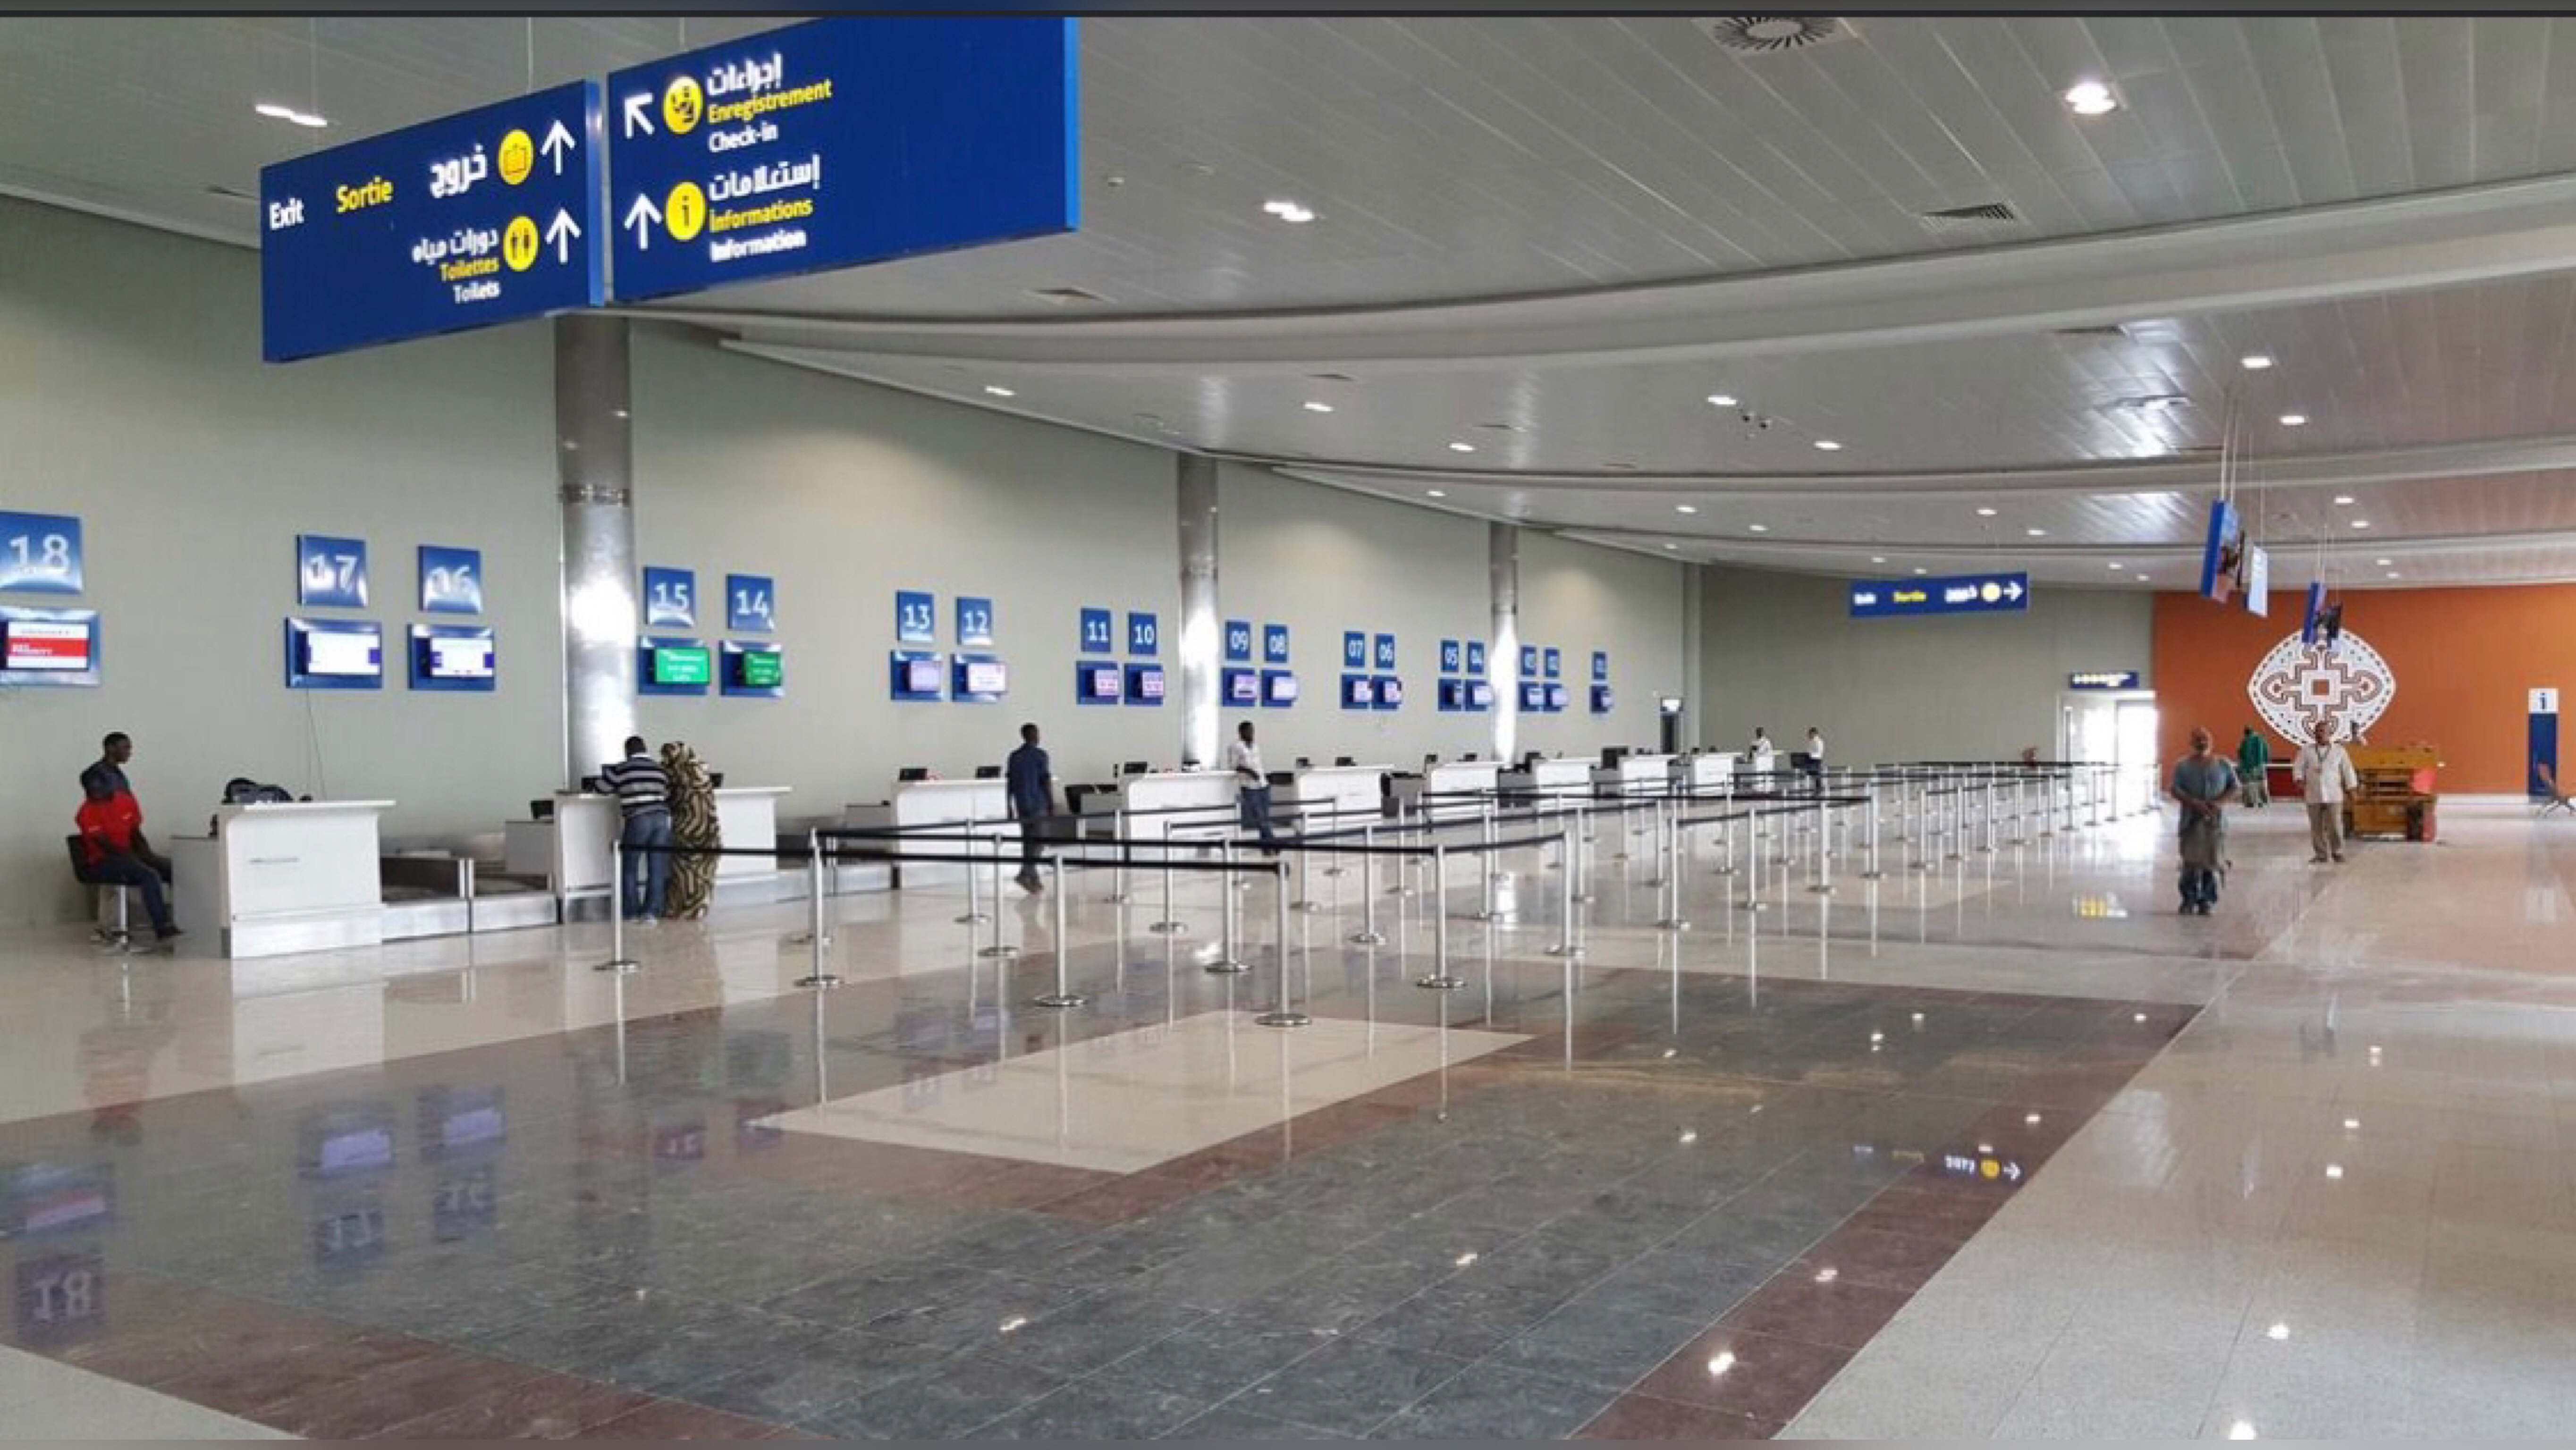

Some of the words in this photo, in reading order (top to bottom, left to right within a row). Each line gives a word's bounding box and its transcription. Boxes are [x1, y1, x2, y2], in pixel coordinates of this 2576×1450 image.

[709, 78, 832, 123] Enregistrement
[708, 120, 778, 153] Check-in
[430, 143, 488, 198] خروج
[336, 176, 394, 213] Sortie
[270, 196, 305, 230] Exit
[709, 228, 807, 262] Information
[439, 258, 499, 281] Toilettes
[453, 281, 501, 303] Toilets
[8, 534, 71, 574] 18
[310, 553, 359, 596] 17
[654, 582, 689, 612] 15
[736, 589, 769, 618] 14
[904, 604, 930, 629] 13
[963, 610, 988, 634] 12
[1087, 620, 1108, 642] 11
[1134, 624, 1155, 645] 10
[1231, 630, 1249, 651] 09
[1269, 634, 1286, 655] 08
[1348, 640, 1363, 659] 07
[1378, 643, 1394, 662] 06
